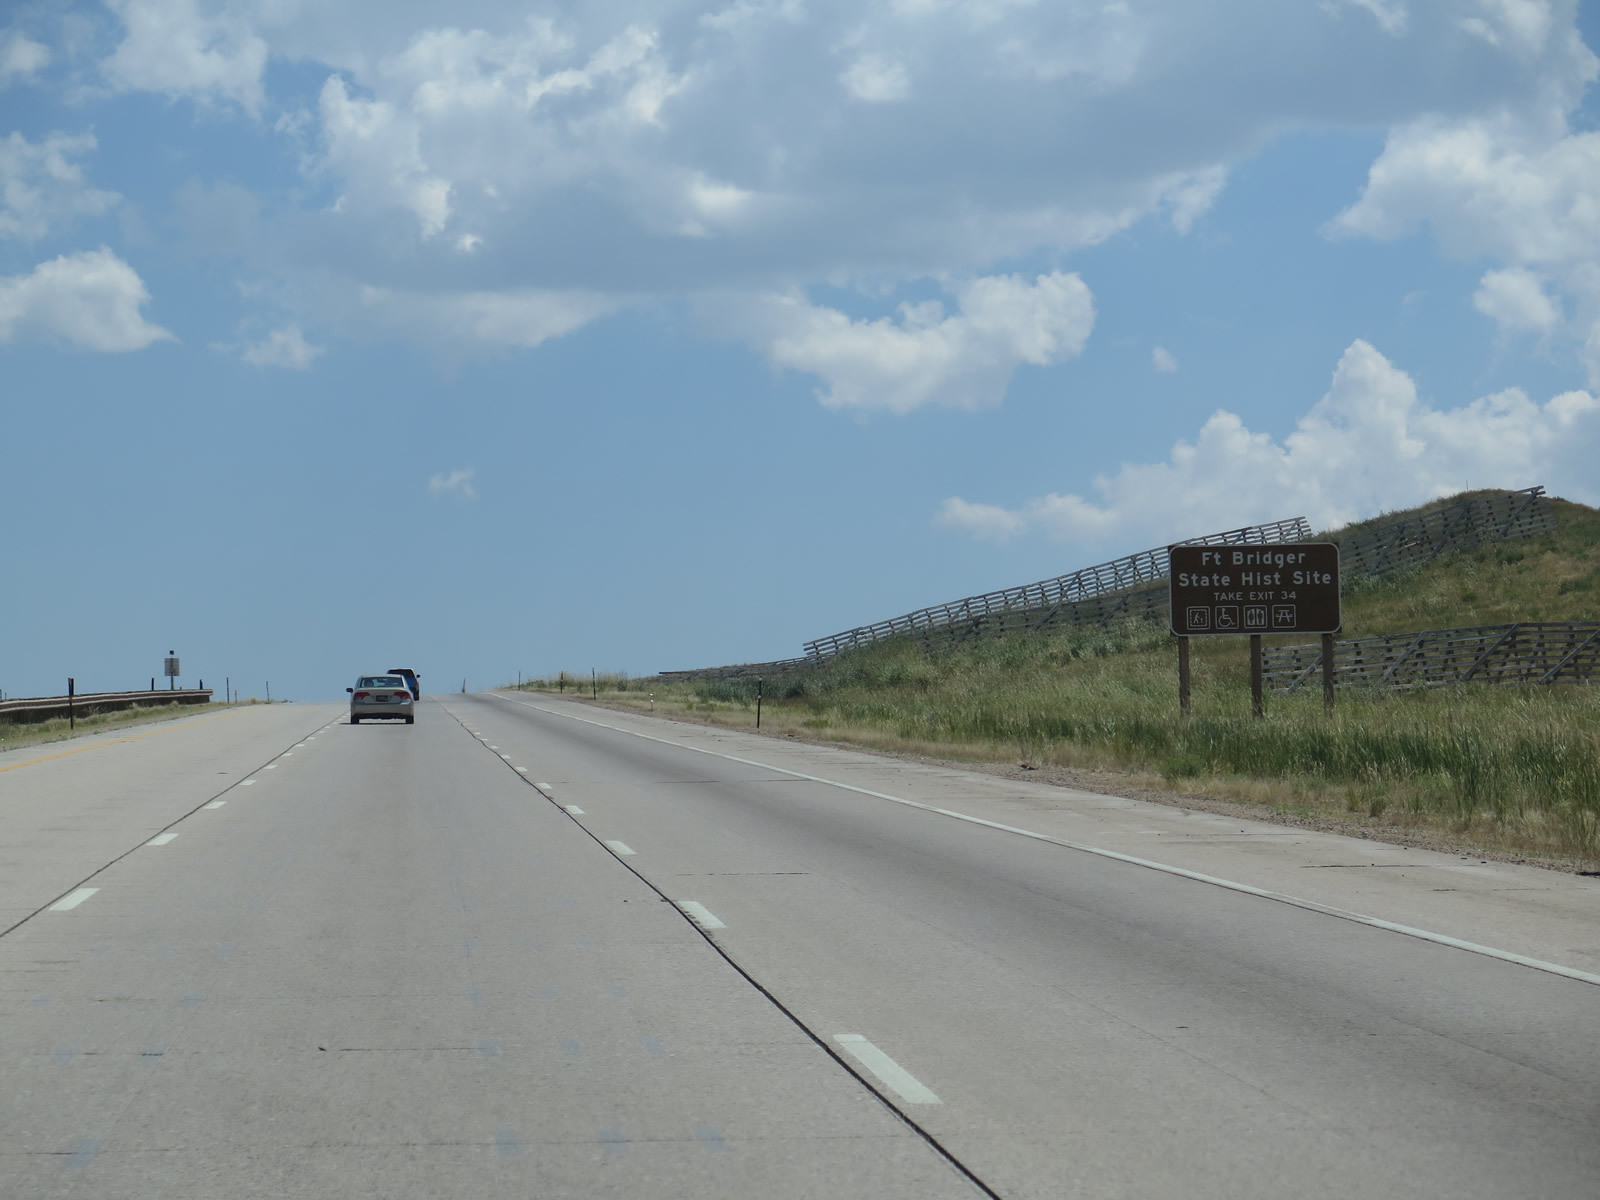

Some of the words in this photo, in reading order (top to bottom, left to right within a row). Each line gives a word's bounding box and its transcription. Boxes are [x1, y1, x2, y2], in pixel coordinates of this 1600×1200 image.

[1202, 552, 1221, 565] Ft
[1232, 551, 1306, 568] Bridger
[1179, 573, 1231, 587] State
[1241, 571, 1281, 586] Hist
[1292, 571, 1332, 585] Site
[1213, 592, 1243, 601] TAKE
[1249, 591, 1274, 600] EXIT
[1281, 591, 1297, 600] 34
